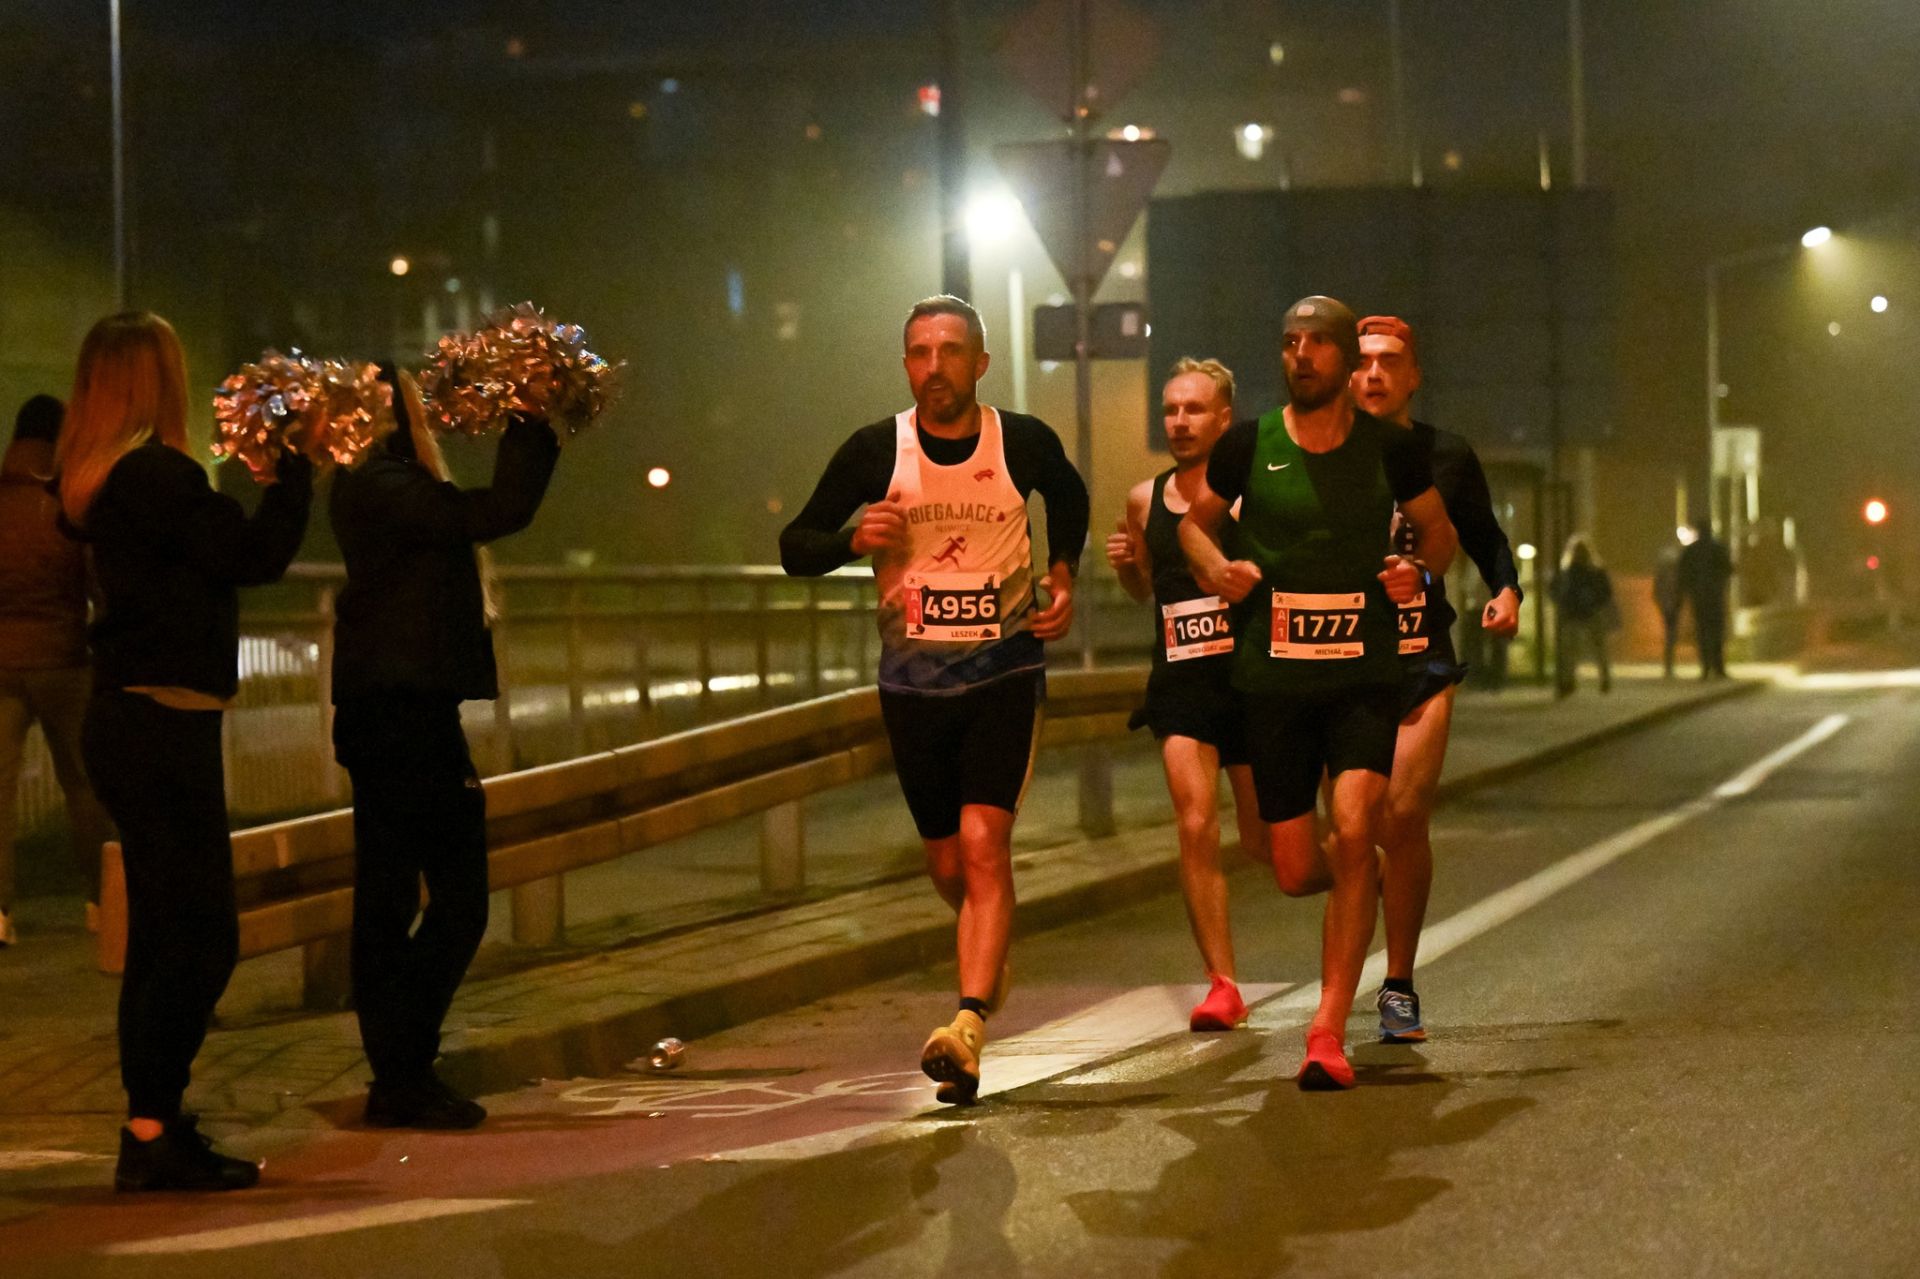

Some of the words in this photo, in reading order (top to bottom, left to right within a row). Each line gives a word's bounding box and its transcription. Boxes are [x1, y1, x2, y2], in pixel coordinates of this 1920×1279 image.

[910, 591, 919, 602] A
[924, 594, 996, 620] 4956
[912, 608, 918, 619] 1
[1277, 610, 1286, 621] A
[1167, 619, 1173, 629] A
[1176, 614, 1230, 641] 1604
[1292, 614, 1359, 638] 1777
[950, 630, 979, 638] LESZEK
[1277, 627, 1284, 638] 1
[1169, 634, 1175, 645] 1
